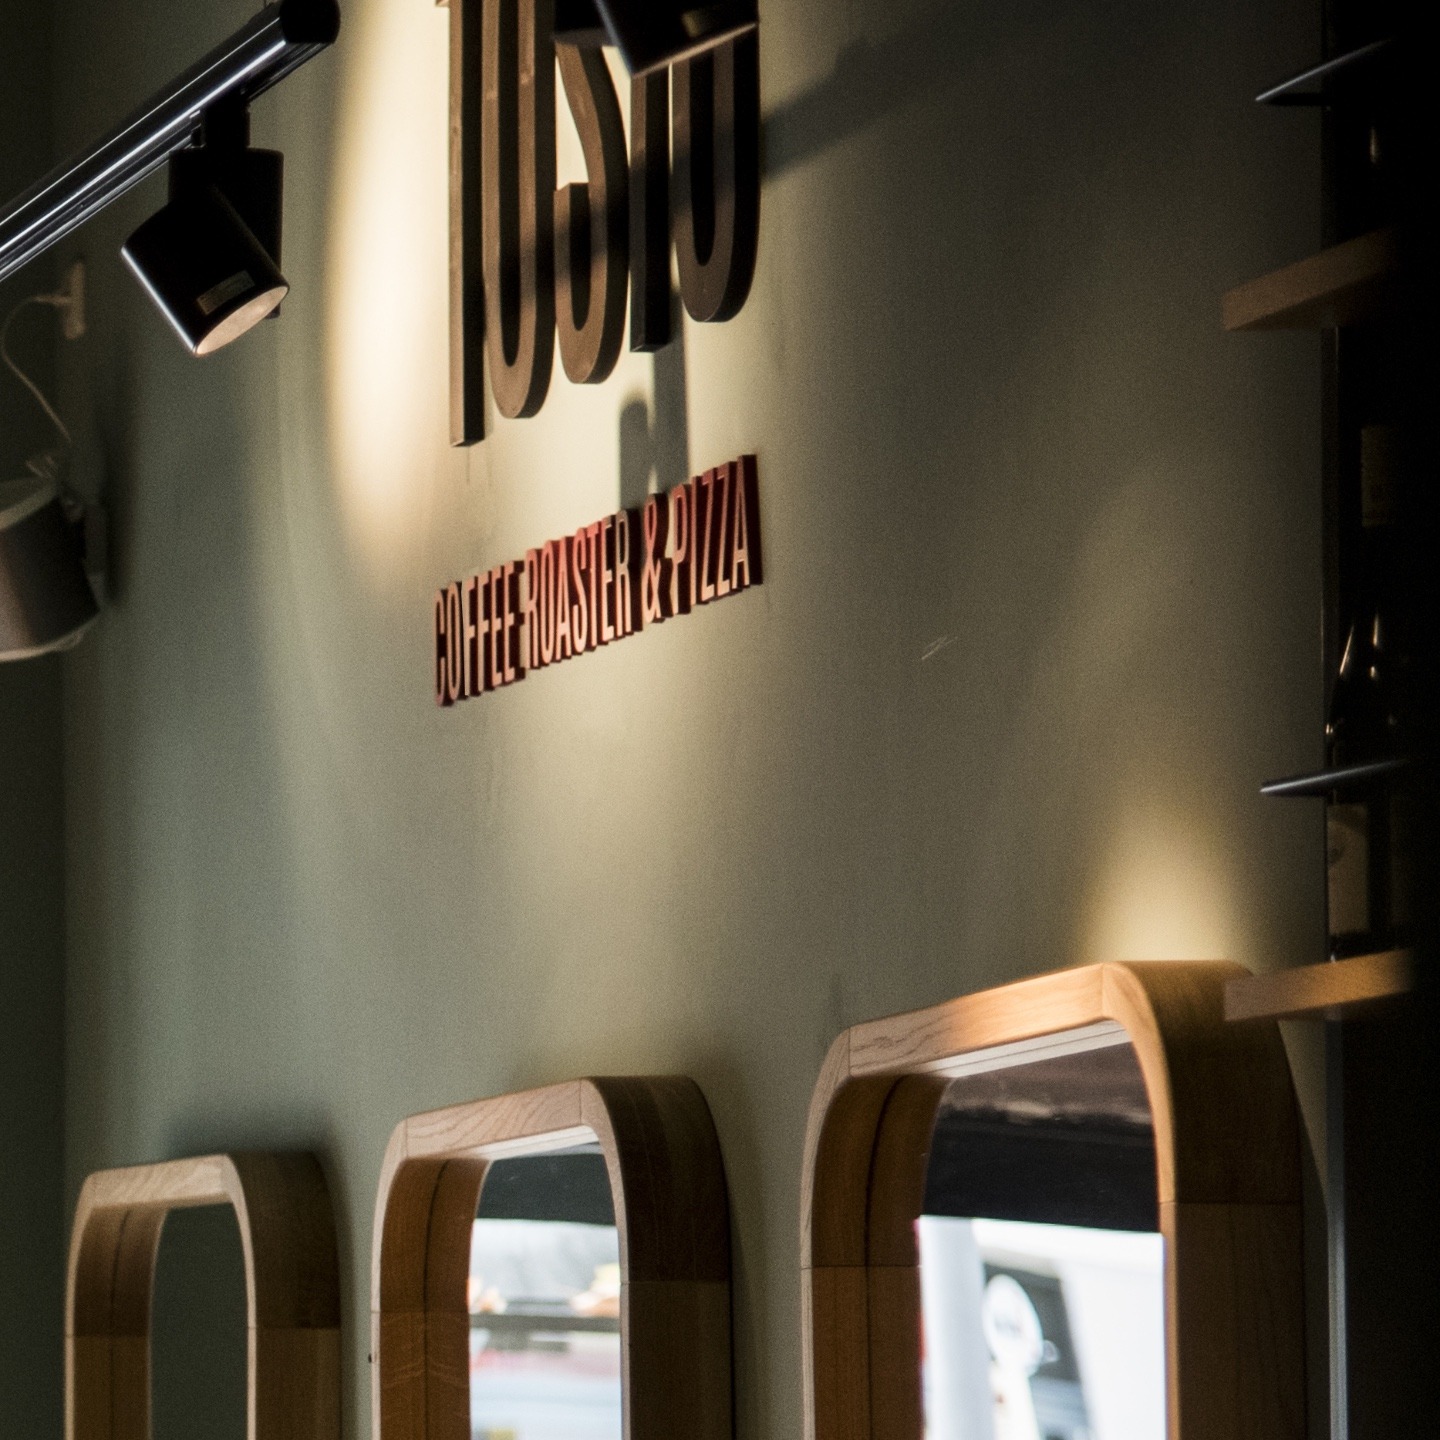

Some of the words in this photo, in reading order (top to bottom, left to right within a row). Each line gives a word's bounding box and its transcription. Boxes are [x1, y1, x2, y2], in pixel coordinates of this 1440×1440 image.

[435, 560, 524, 706] COFFEE
[523, 508, 641, 670] ROASTER
[641, 493, 669, 623] &
[670, 454, 762, 615] PIZZA
